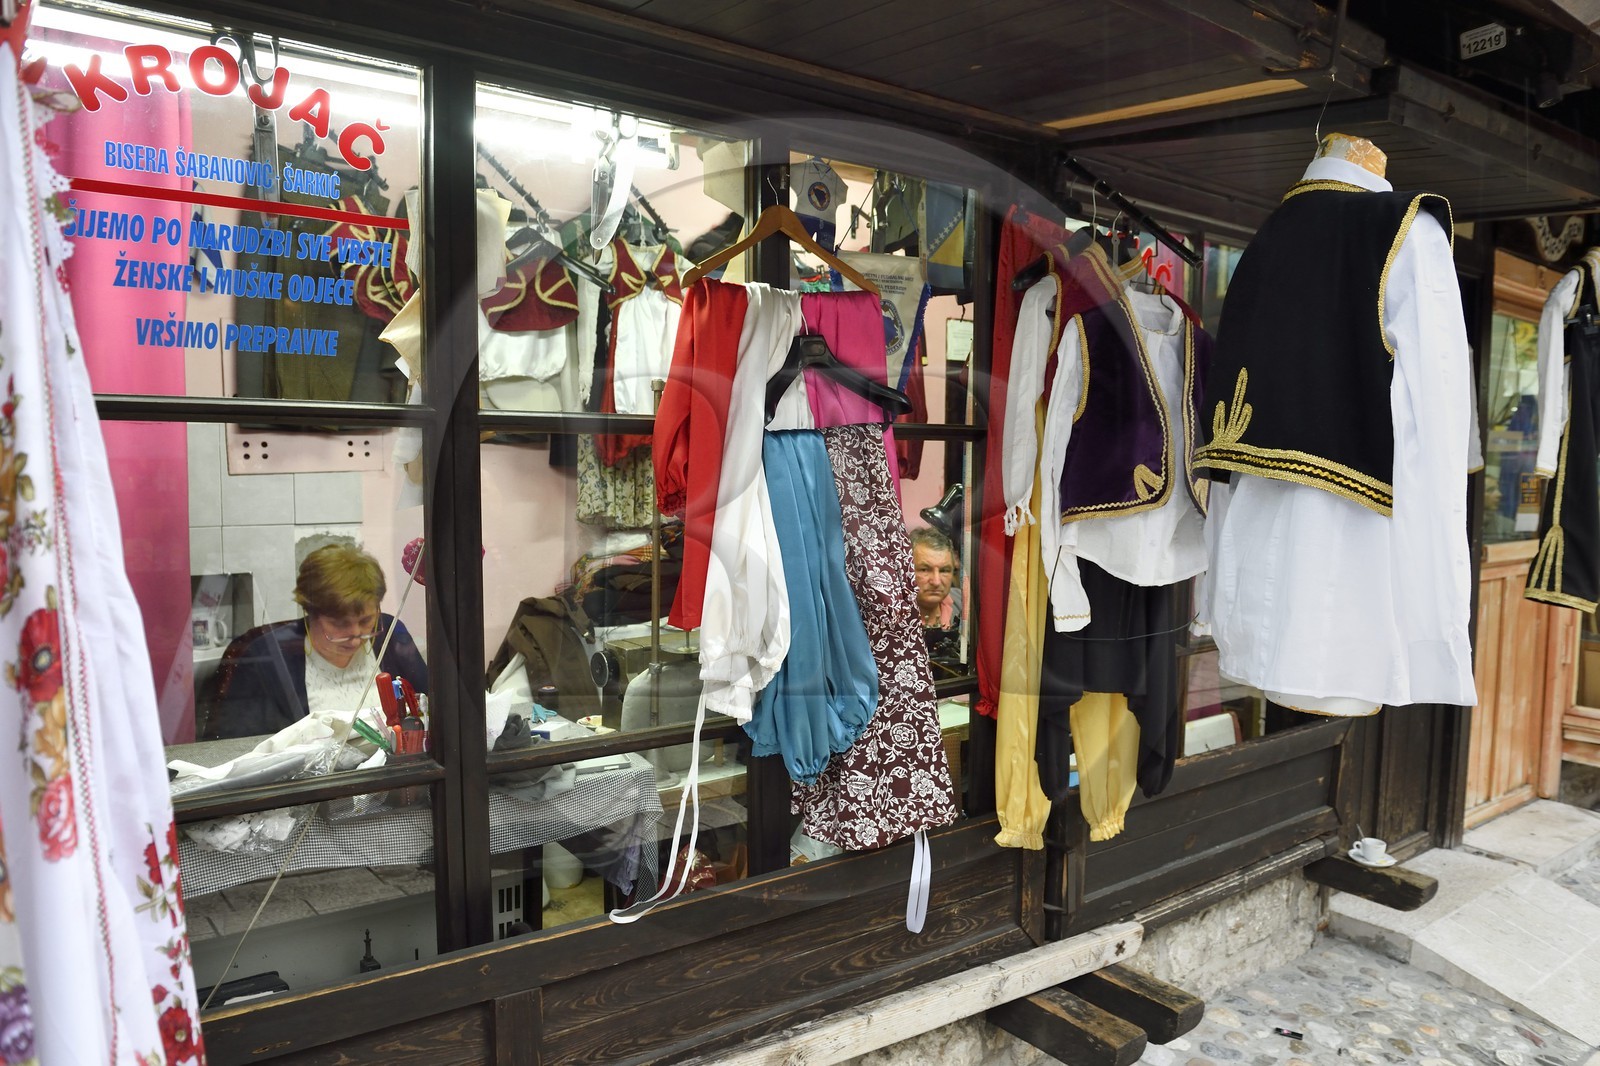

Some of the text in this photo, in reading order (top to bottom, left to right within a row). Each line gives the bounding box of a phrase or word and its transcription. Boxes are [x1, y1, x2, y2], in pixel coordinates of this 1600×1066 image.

[1466, 34, 1501, 54] 12219
[63, 44, 390, 171] KROJAČ
[105, 141, 169, 174] BISERA
[64, 199, 392, 269] ŠIJEMO PO NARUDŽBI SVE VRSTE
[113, 251, 355, 306] ŽENSKE I MUŠKE ODJEĆE
[135, 312, 339, 357] VRŠIMO PREPRAVKE
